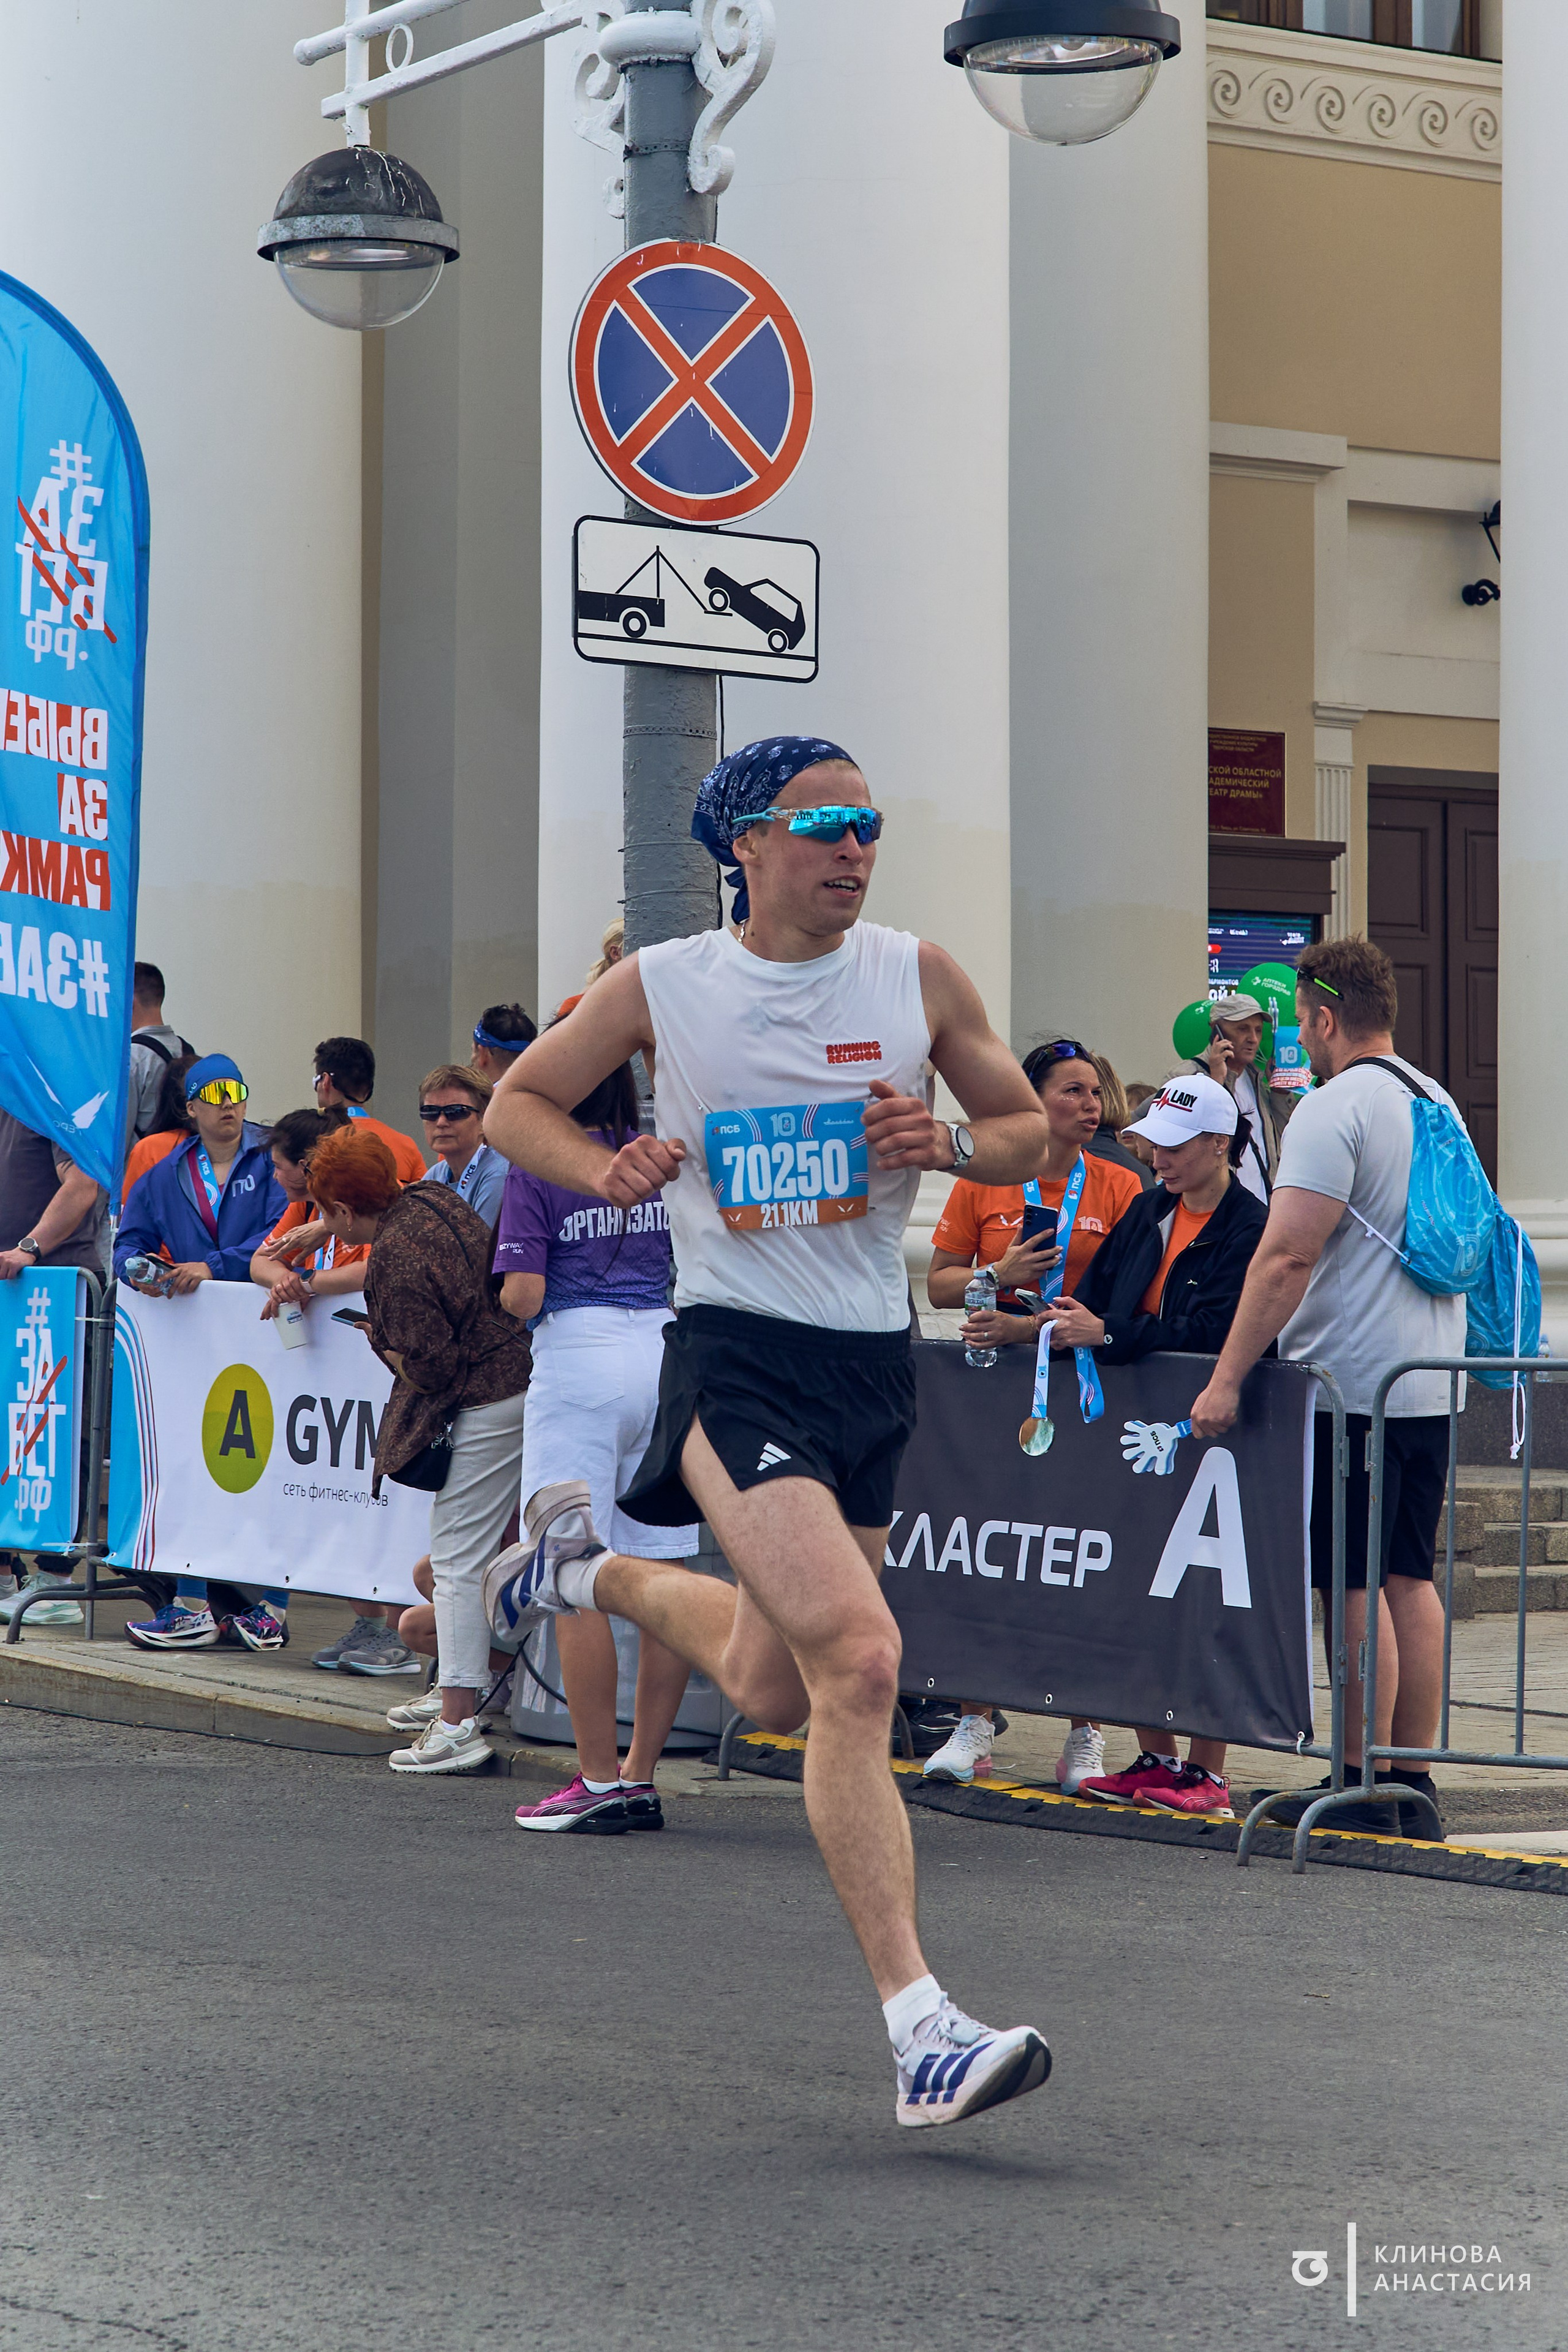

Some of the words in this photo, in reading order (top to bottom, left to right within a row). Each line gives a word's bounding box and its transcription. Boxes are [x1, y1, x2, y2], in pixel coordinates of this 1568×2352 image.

[1232, 767, 1281, 778] ОБЛАСТНОЙ
[1209, 788, 1228, 796] ЕАТР
[826, 1040, 881, 1055] RUNNING
[827, 1050, 882, 1065] RELIGION
[1170, 1089, 1198, 1108] LADY
[720, 1123, 741, 1135] ПСБ
[769, 1112, 796, 1137] 10
[201, 1161, 211, 1176] ПСБ
[464, 1164, 477, 1181] ПСБ
[722, 1139, 850, 1203] 70250
[1026, 1180, 1036, 1193] СБ
[1072, 1172, 1083, 1189] ПСБ
[16, 1328, 58, 1403] ЗА
[8, 1402, 67, 1479] БЕГ
[1150, 1430, 1161, 1446] ПСБ
[282, 1482, 307, 1498] сеть
